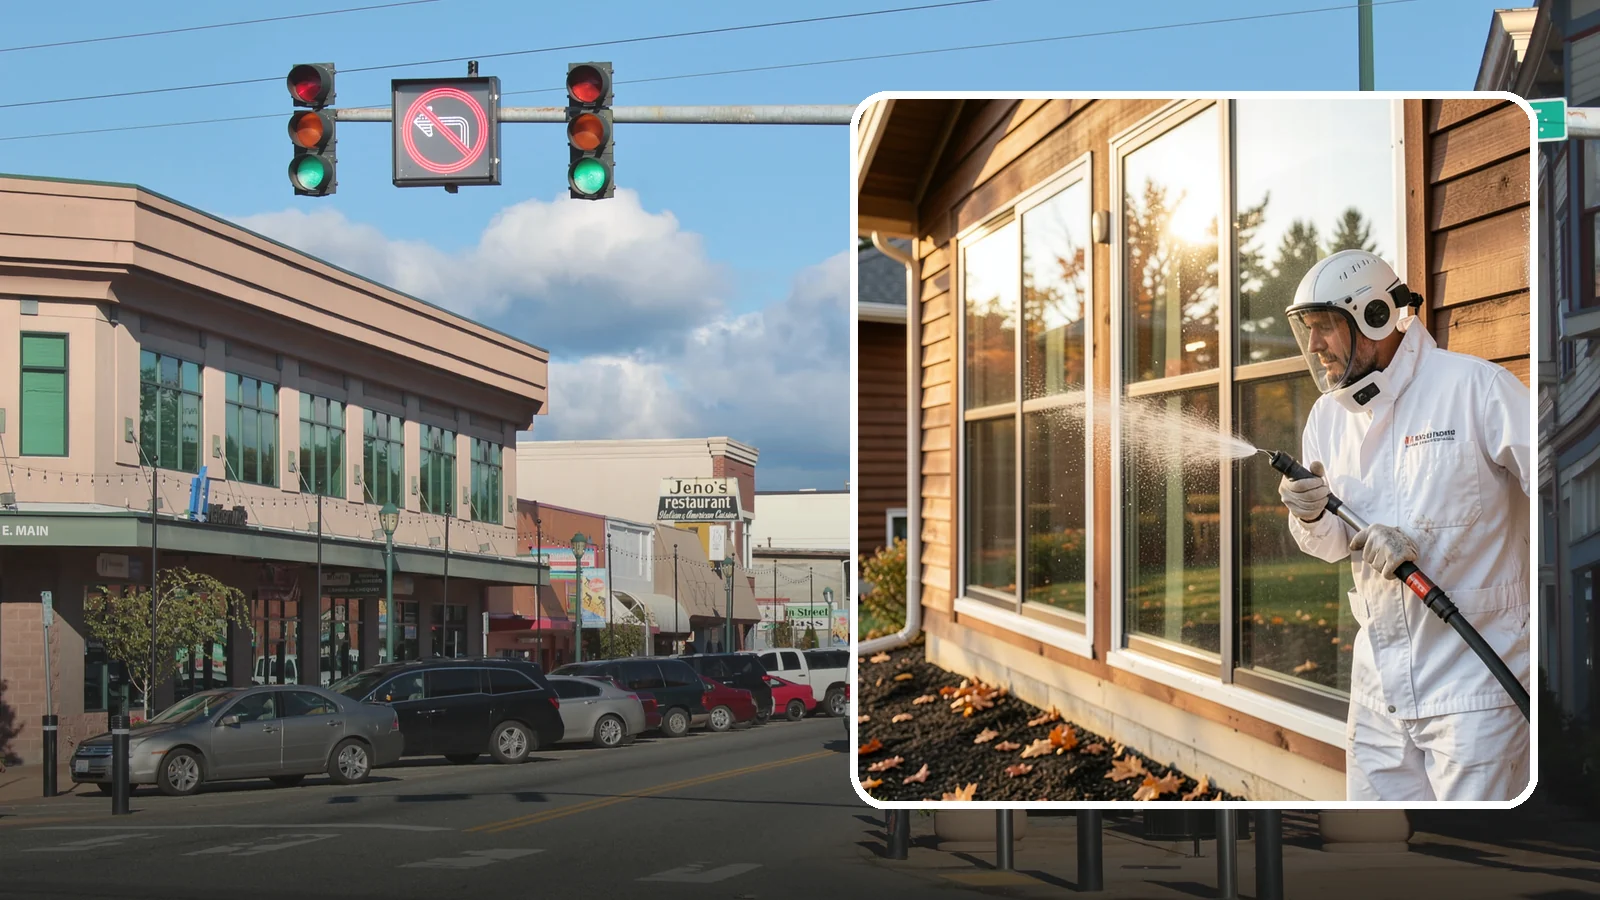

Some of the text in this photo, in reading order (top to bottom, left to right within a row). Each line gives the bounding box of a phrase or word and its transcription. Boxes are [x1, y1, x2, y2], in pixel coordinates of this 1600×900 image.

[669, 480, 727, 494] Jeno's
[665, 496, 731, 509] restaurant
[686, 510, 714, 519] American
[715, 509, 737, 519] Cuisine
[2, 525, 49, 536] E. MAIN
[797, 608, 828, 617] Street
